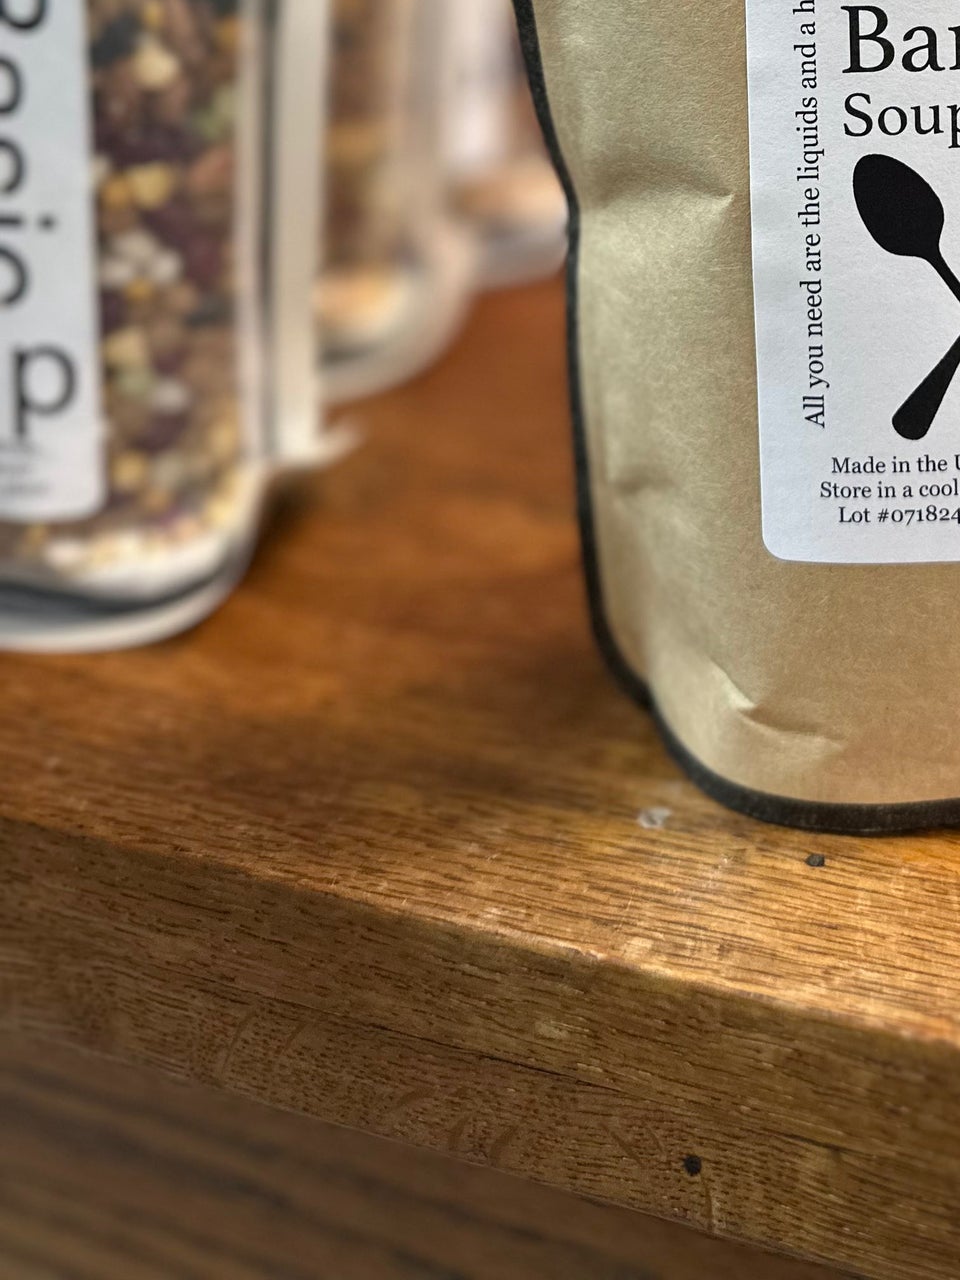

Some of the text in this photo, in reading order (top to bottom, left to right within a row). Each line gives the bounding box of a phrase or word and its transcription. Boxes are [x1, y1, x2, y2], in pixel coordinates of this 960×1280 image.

[800, 21, 816, 35] a
[793, 42, 818, 89] and
[795, 96, 825, 182] liquids
[797, 187, 821, 228] the
[805, 233, 823, 272] are
[799, 279, 824, 337] need
[808, 344, 830, 389] you
[802, 395, 827, 429] All
[831, 456, 886, 474] Made
[892, 456, 911, 473] in
[917, 454, 948, 472] the
[820, 481, 872, 499] Store
[877, 481, 897, 498] in
[903, 486, 913, 498] a
[838, 506, 871, 524] Lot
